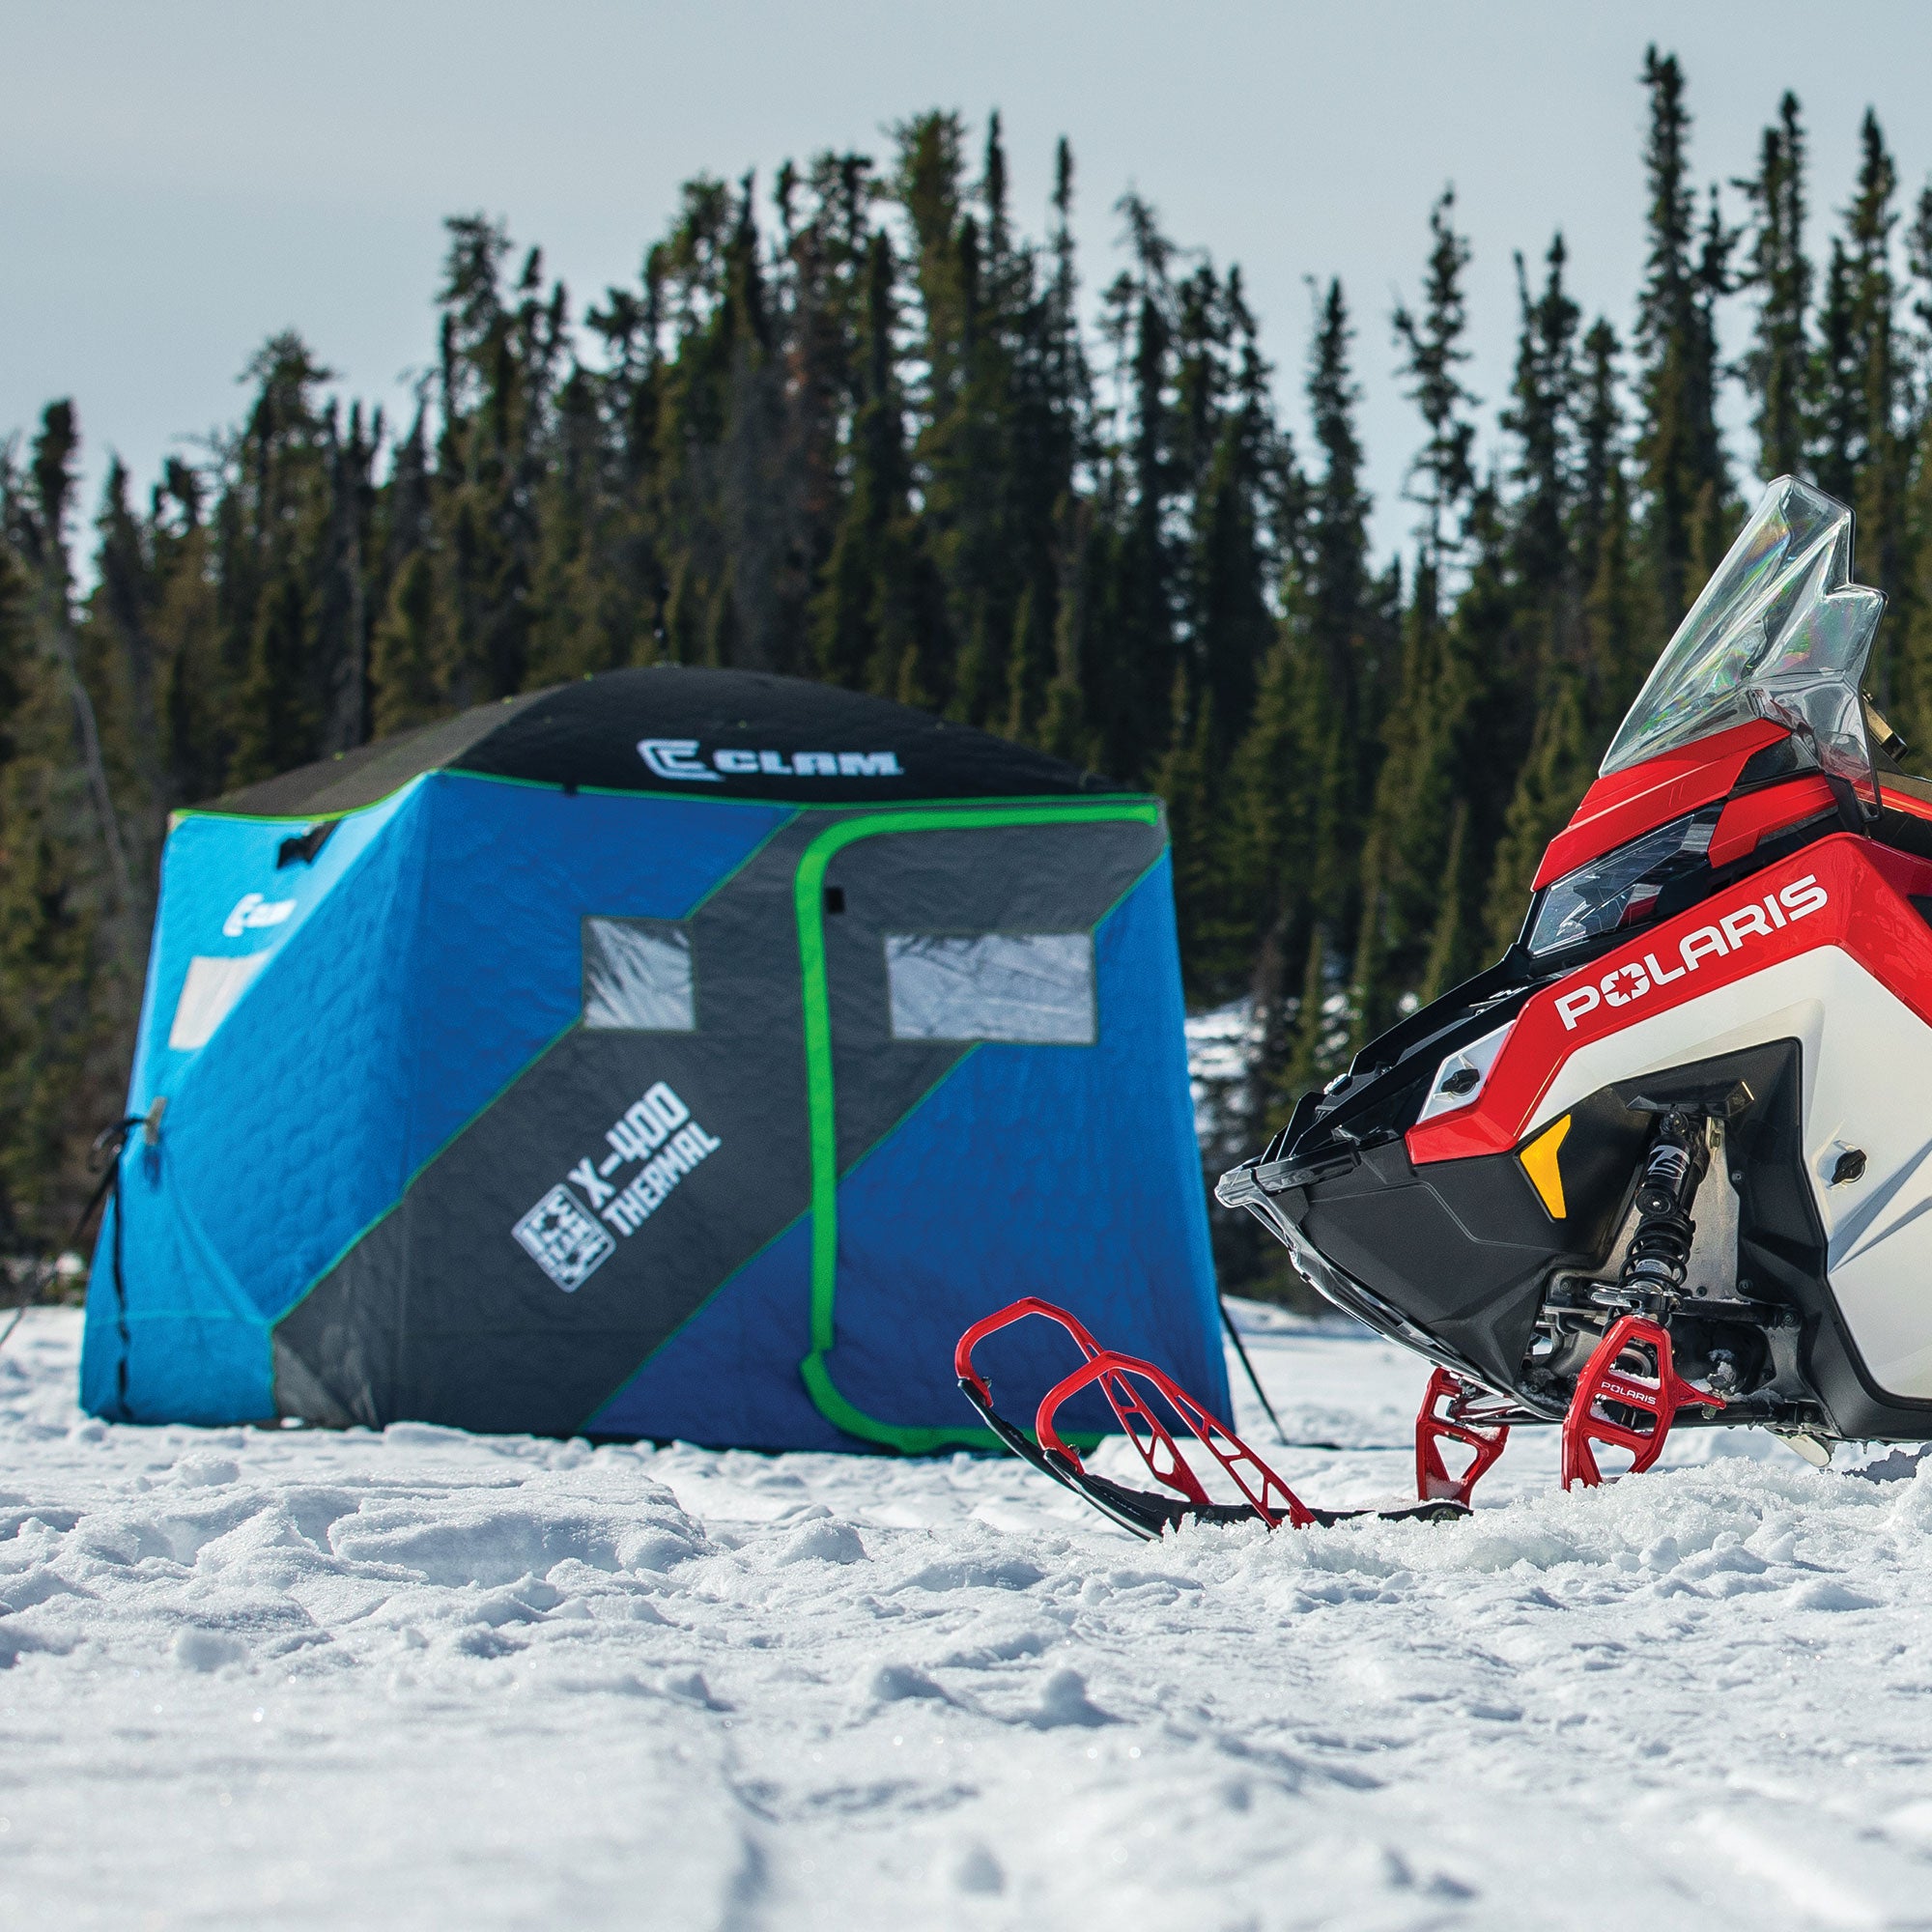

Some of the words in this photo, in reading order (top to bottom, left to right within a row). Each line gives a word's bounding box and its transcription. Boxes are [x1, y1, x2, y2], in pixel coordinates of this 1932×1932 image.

[713, 749, 900, 777] CLAM
[1553, 873, 1829, 1032] POLARIS
[567, 1081, 692, 1209] X-400
[601, 1121, 723, 1237] THERMAL
[1601, 1381, 1657, 1406] POLARIS
